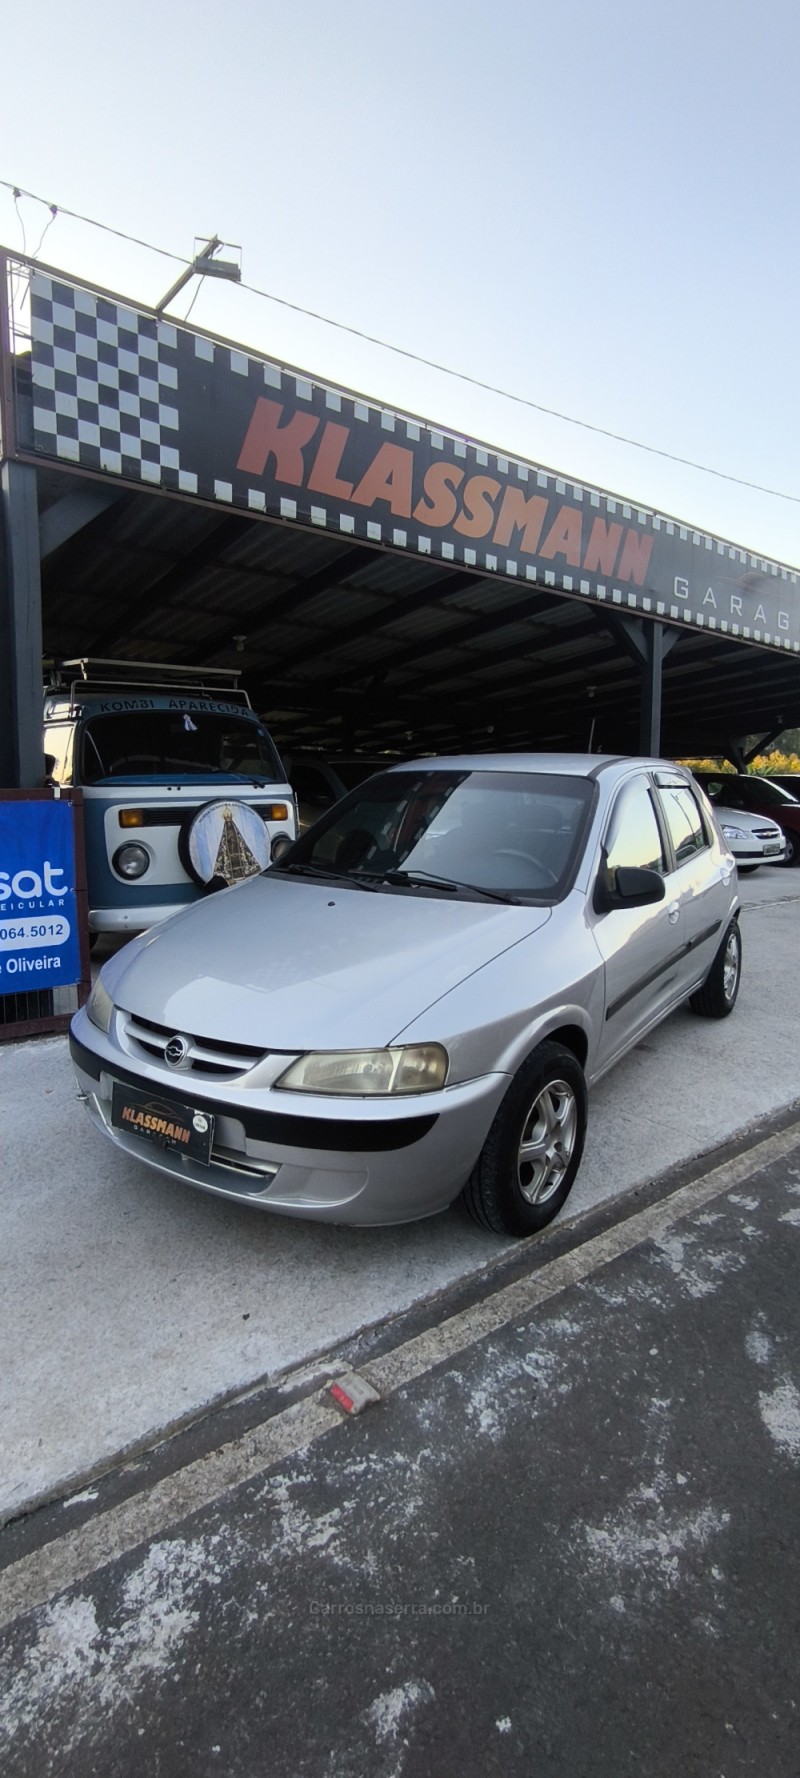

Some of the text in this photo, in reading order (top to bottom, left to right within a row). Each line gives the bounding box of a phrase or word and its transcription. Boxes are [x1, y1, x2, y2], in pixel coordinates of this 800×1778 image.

[236, 396, 655, 586] KLASSMANN
[673, 576, 789, 630] GARAG
[100, 699, 249, 716] KOMBI APARECIDA
[0, 923, 64, 940] 064.5012
[6, 955, 61, 974] Oliveira
[121, 1106, 191, 1144] KLASSMANN
